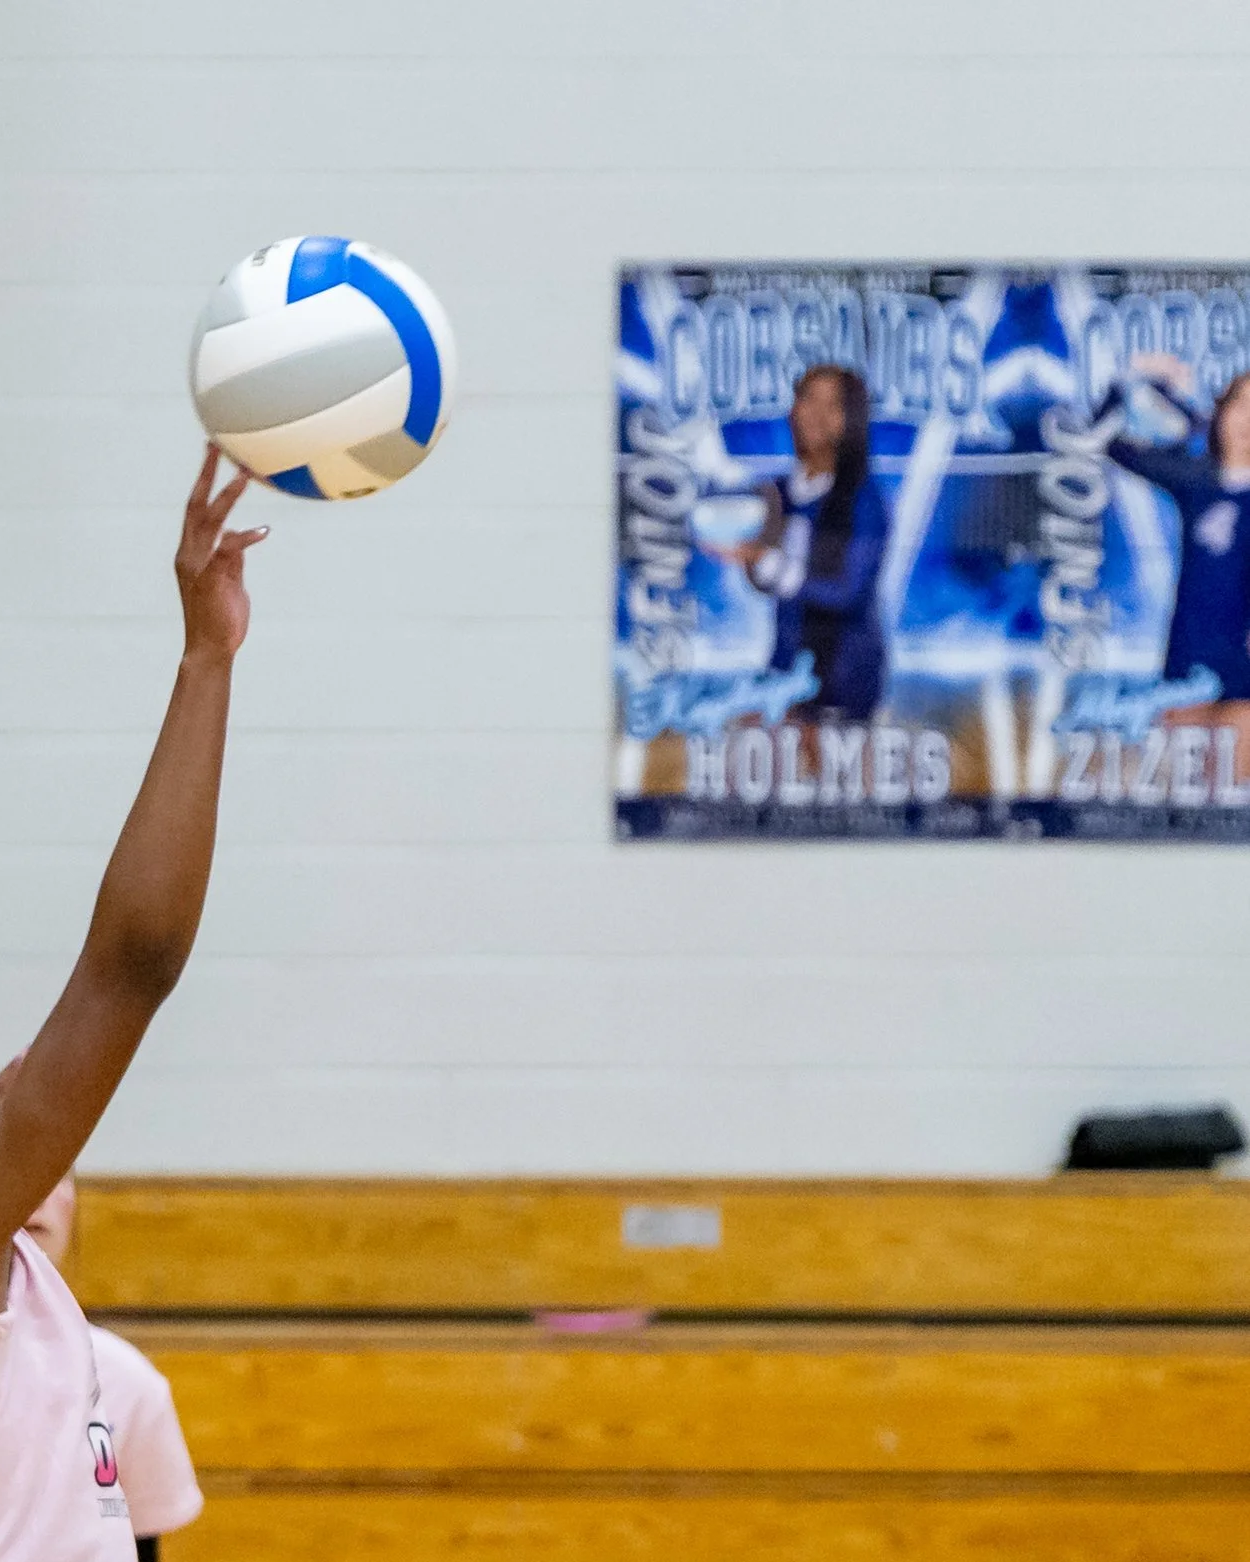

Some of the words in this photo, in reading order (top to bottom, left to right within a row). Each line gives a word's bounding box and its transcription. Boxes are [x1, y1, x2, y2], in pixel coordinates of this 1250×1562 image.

[1080, 286, 1250, 420] CORS
[686, 724, 953, 803] HOLMES
[1057, 724, 1250, 803] ZIZEL
